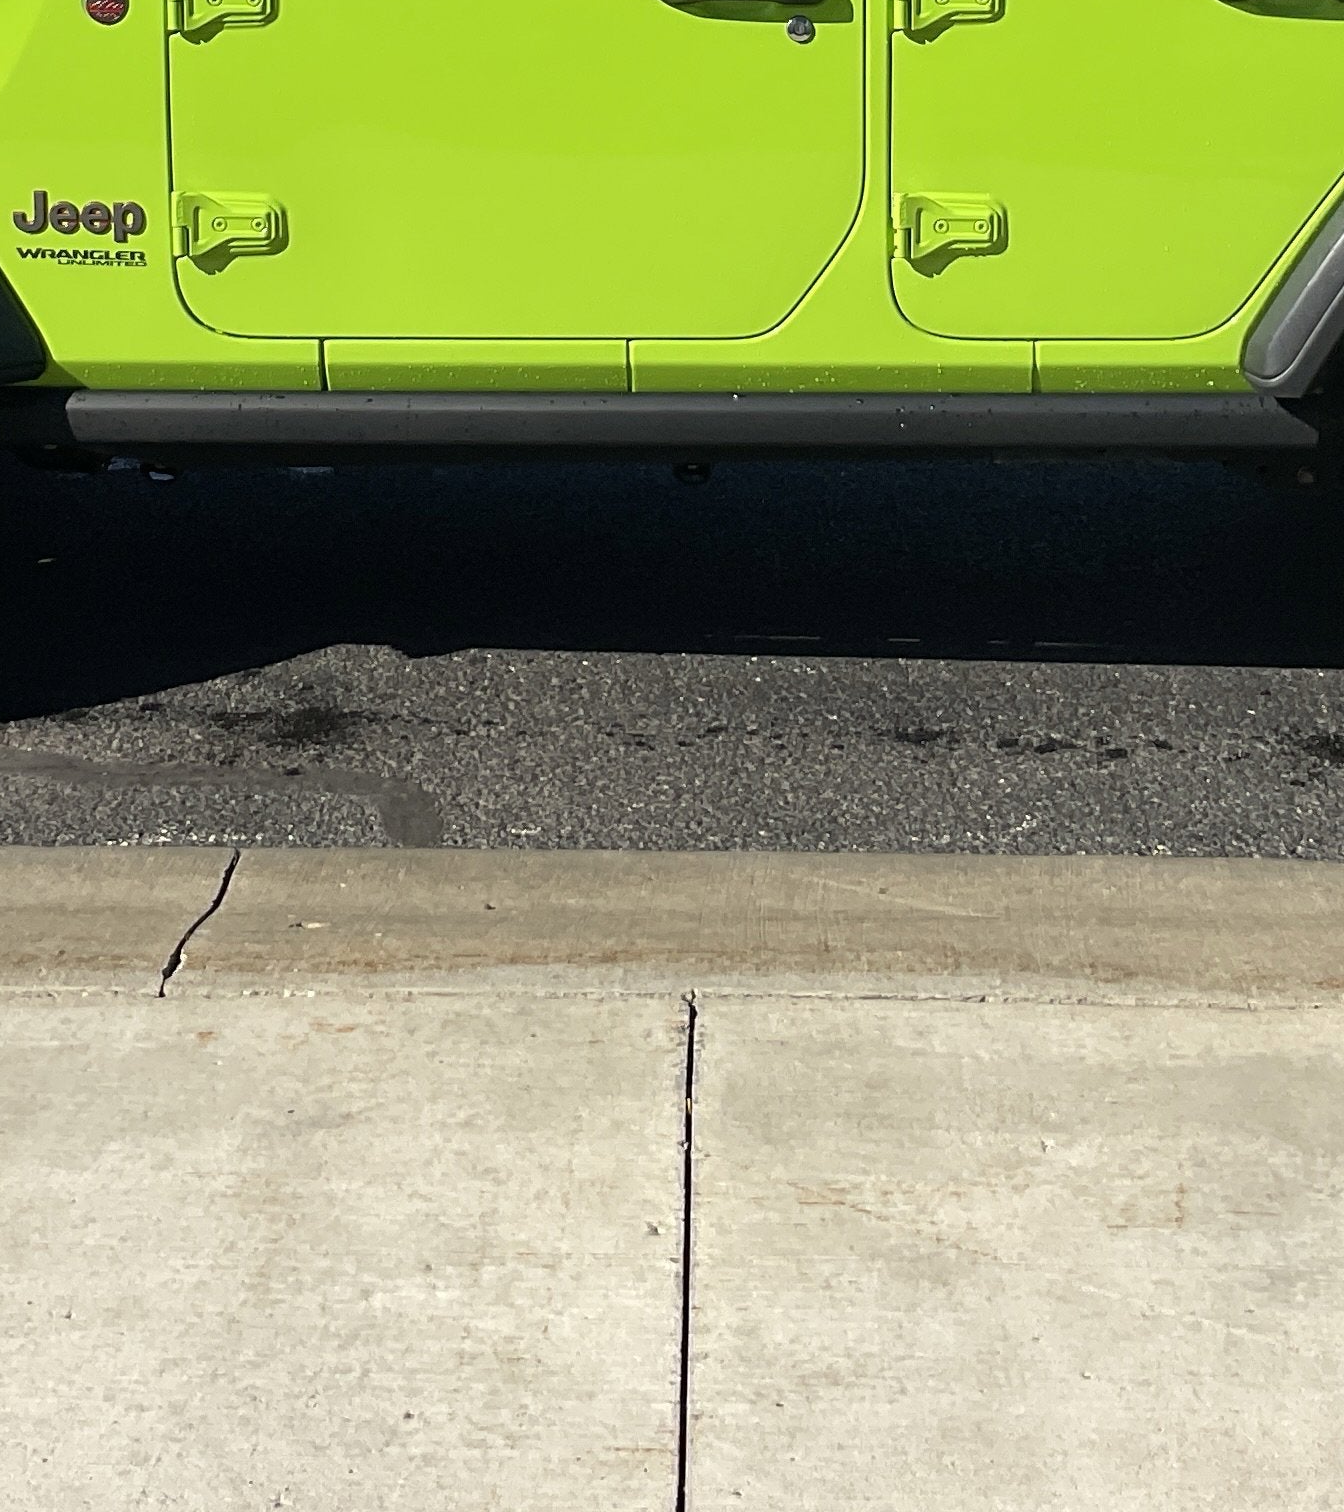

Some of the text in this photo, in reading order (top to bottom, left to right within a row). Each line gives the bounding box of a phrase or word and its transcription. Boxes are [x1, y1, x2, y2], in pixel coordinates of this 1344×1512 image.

[13, 190, 147, 243] Jeep
[16, 247, 146, 261] WRANGLER
[58, 258, 147, 267] UNLIMITED
